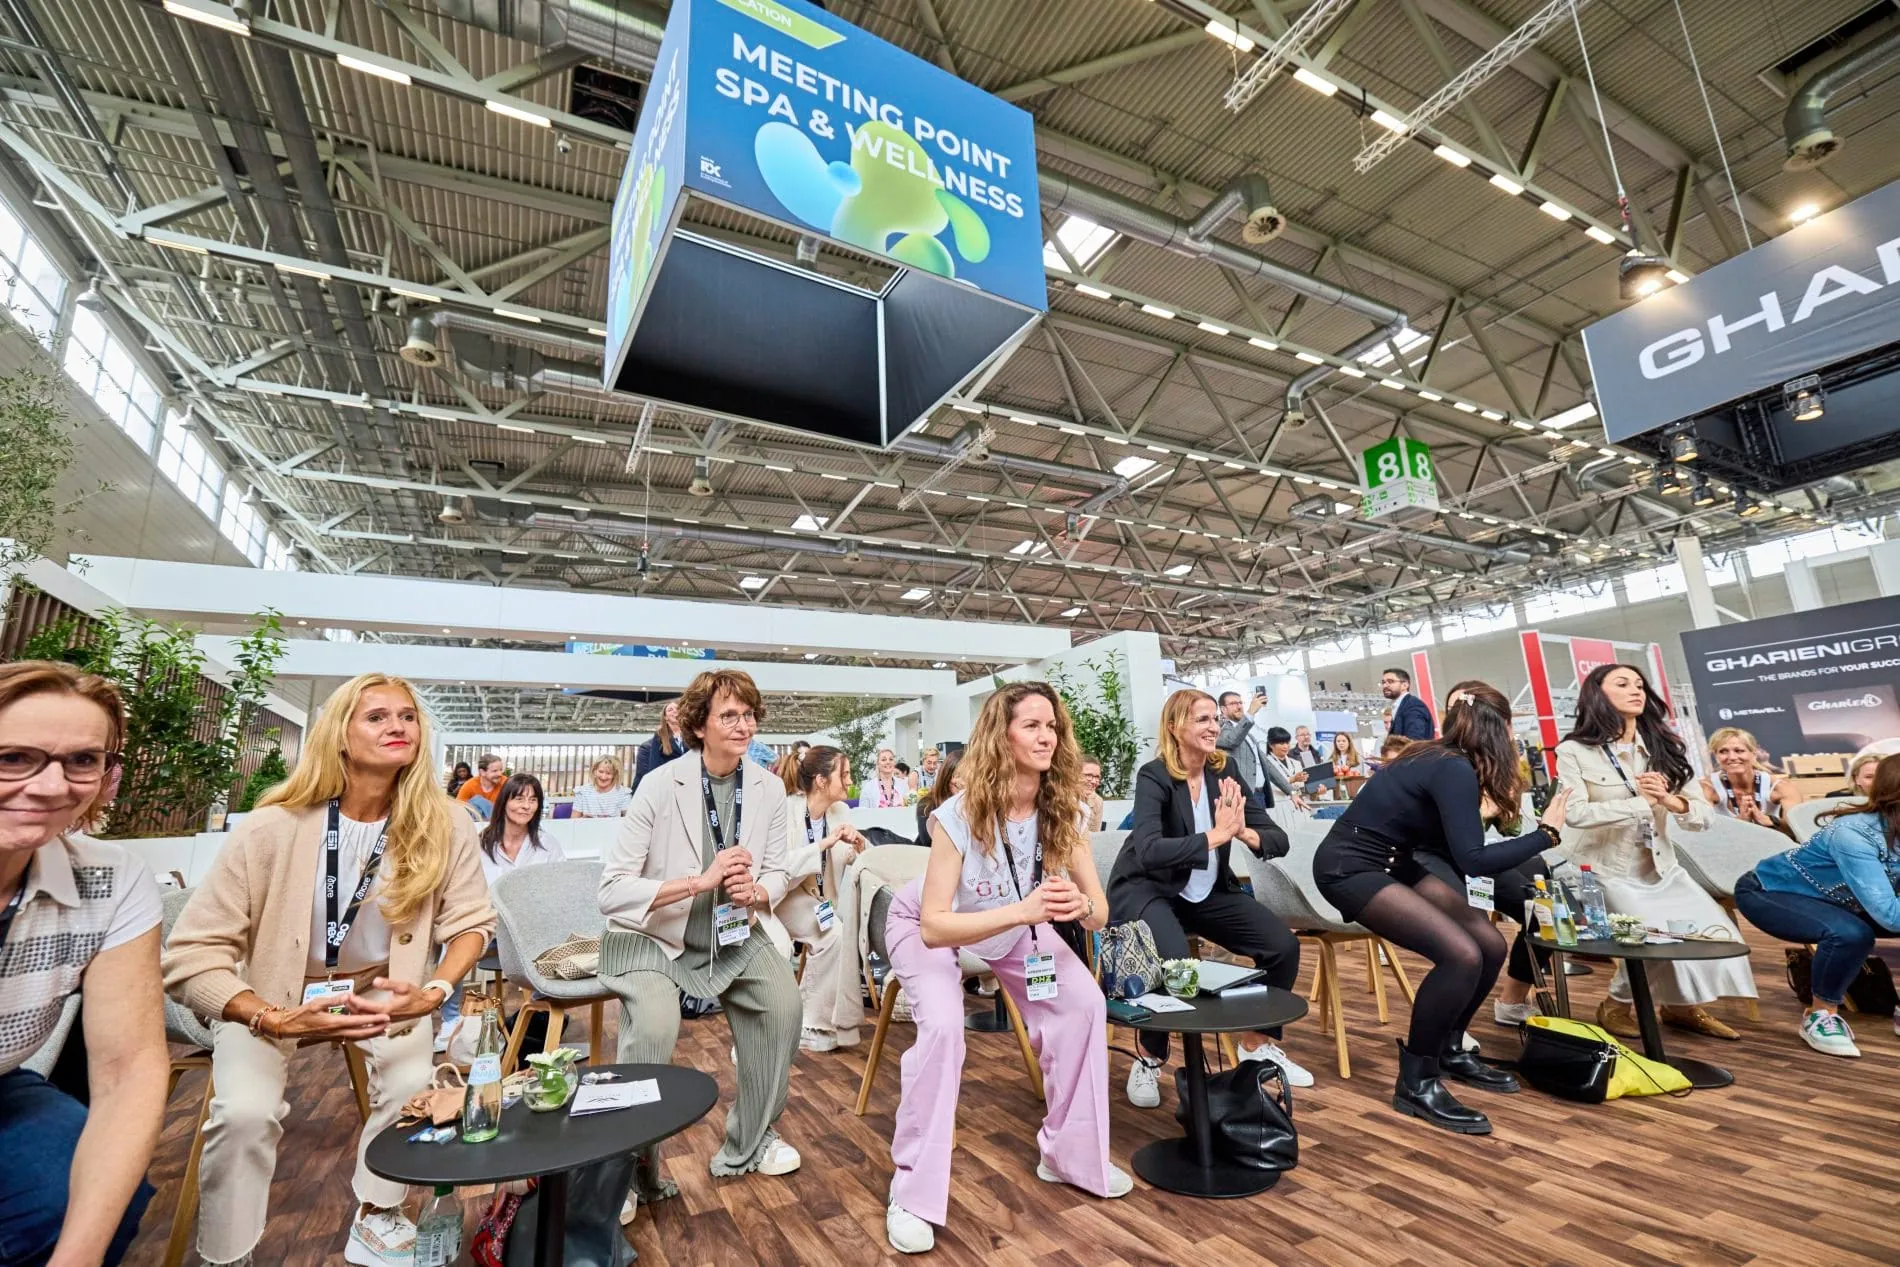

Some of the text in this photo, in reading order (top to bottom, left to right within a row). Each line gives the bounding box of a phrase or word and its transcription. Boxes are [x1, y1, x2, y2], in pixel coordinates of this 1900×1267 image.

[732, 32, 1011, 180] MEETING POINT
[715, 68, 1025, 219] SPA & WELLNESS
[1377, 452, 1400, 482] 8
[1415, 452, 1431, 481] 8
[1706, 633, 1900, 673] GHARIENIGR
[1758, 673, 1777, 683] THE
[1778, 668, 1818, 681] BRANDS
[1818, 666, 1838, 675] FOR
[1839, 662, 1869, 673] YOUR
